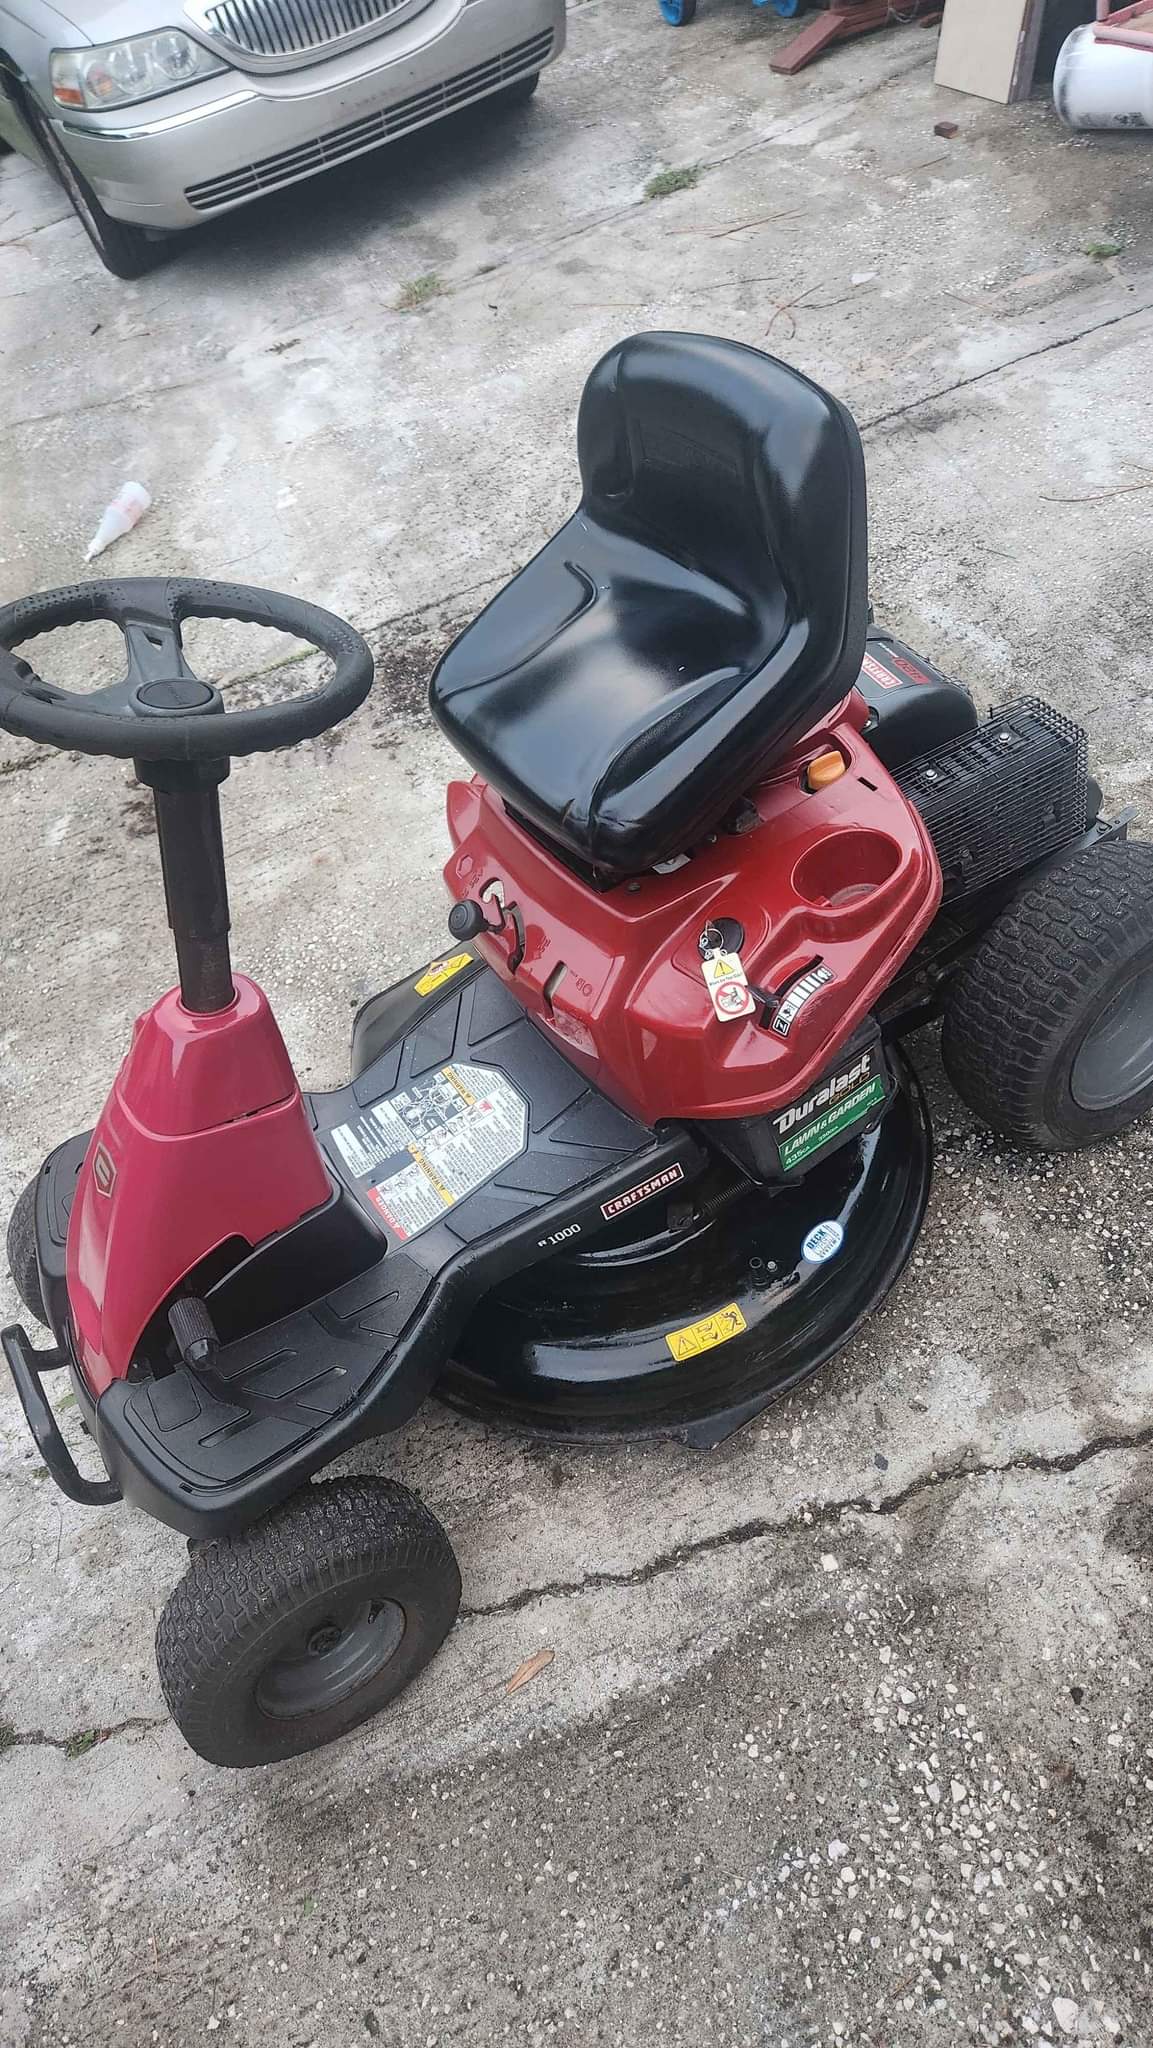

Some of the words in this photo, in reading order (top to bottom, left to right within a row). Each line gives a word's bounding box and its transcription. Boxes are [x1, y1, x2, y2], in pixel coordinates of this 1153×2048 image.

[773, 1055, 870, 1134] Duralast
[829, 1072, 870, 1105] GOLD
[784, 1122, 821, 1156] LAWN
[828, 1082, 876, 1124] GARDEN
[419, 1158, 441, 1186] WARNING
[607, 1168, 679, 1214] CRAFTSMAN
[375, 1196, 397, 1227] DANGER
[806, 1229, 826, 1250] DECK
